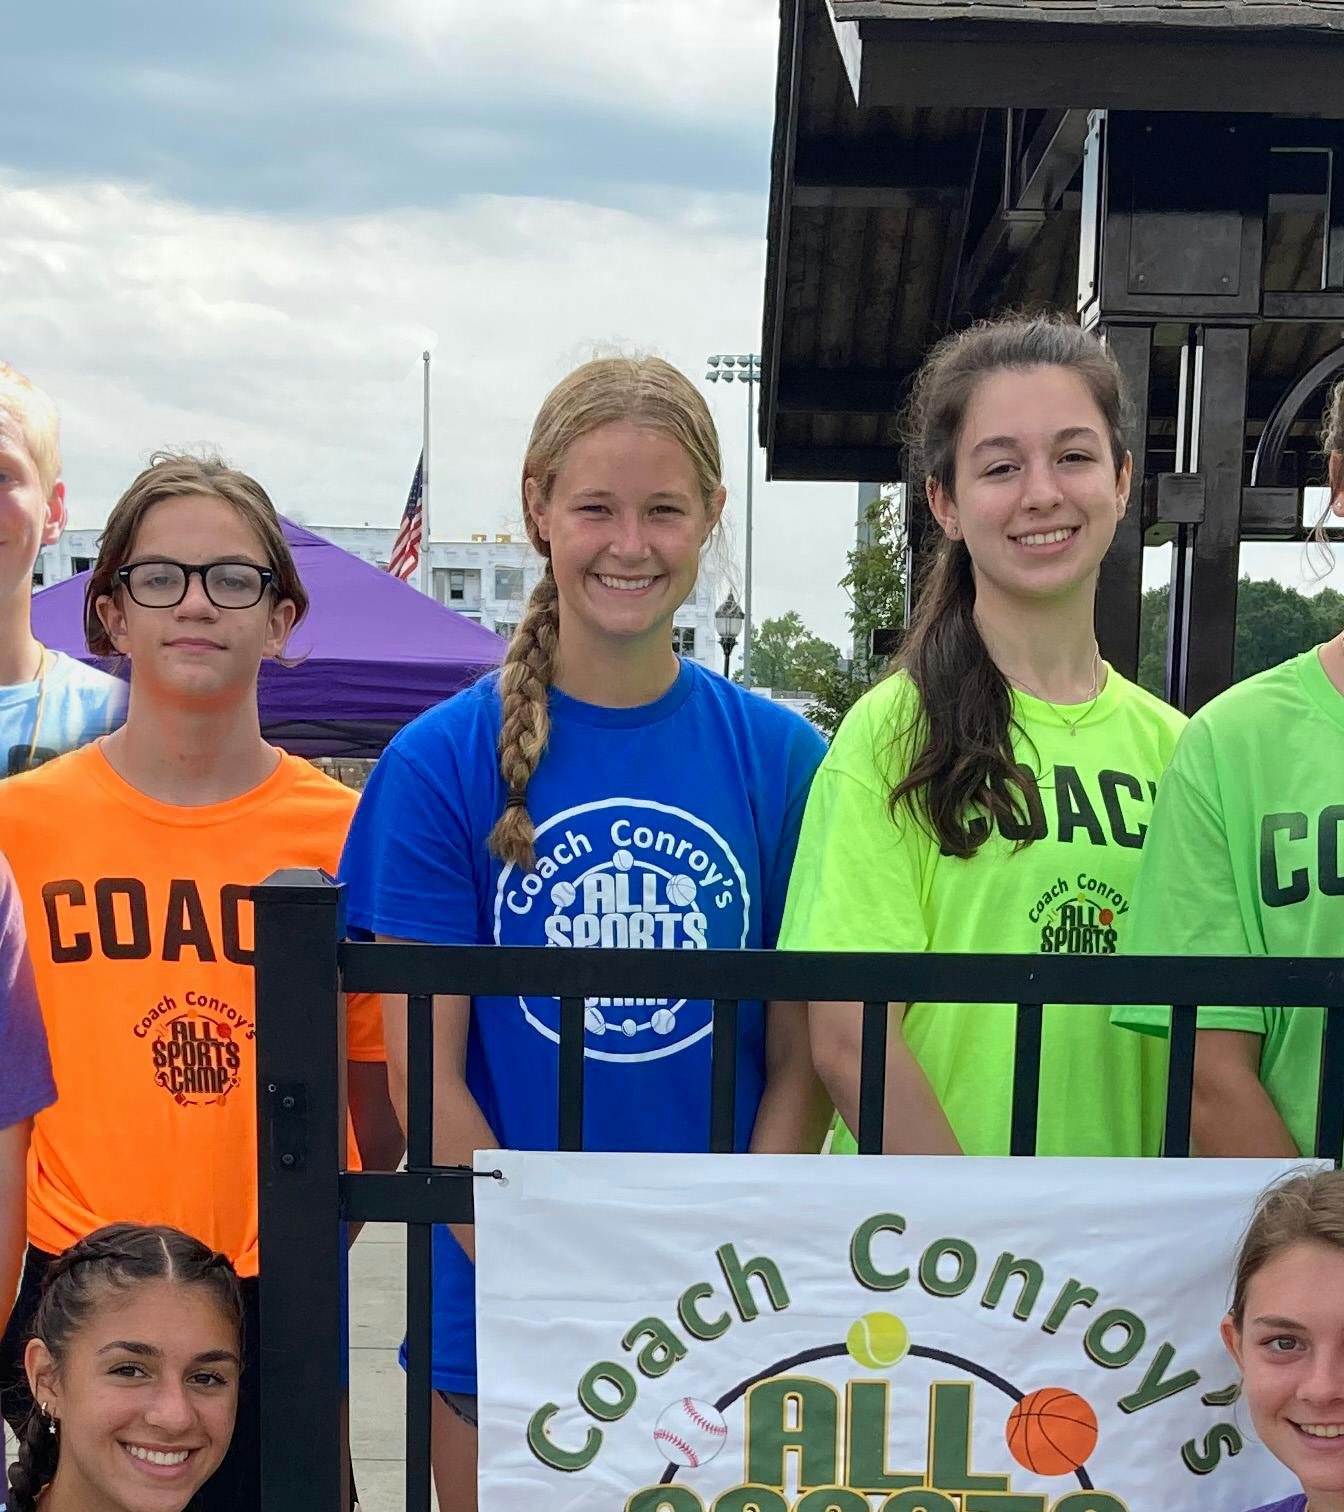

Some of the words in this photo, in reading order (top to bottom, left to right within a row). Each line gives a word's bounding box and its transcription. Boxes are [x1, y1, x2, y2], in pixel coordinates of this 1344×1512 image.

[505, 829, 593, 916] Coach
[610, 819, 733, 909] Conroy's
[583, 872, 670, 914] ALL
[1028, 877, 1069, 924] Coach
[41, 877, 254, 967] COAC
[544, 911, 707, 950] SPORTS
[1061, 904, 1100, 929] ALL
[1040, 924, 1118, 954] SPORTS
[133, 995, 177, 1039] Coach
[185, 991, 256, 1041] Conroy's
[171, 1020, 219, 1042] ALL
[151, 1039, 241, 1069] SPORTS
[169, 1066, 229, 1094] CAMP
[527, 1241, 791, 1473] Coach
[848, 1211, 1244, 1476] Conroy's
[743, 1374, 1012, 1495] ALL
